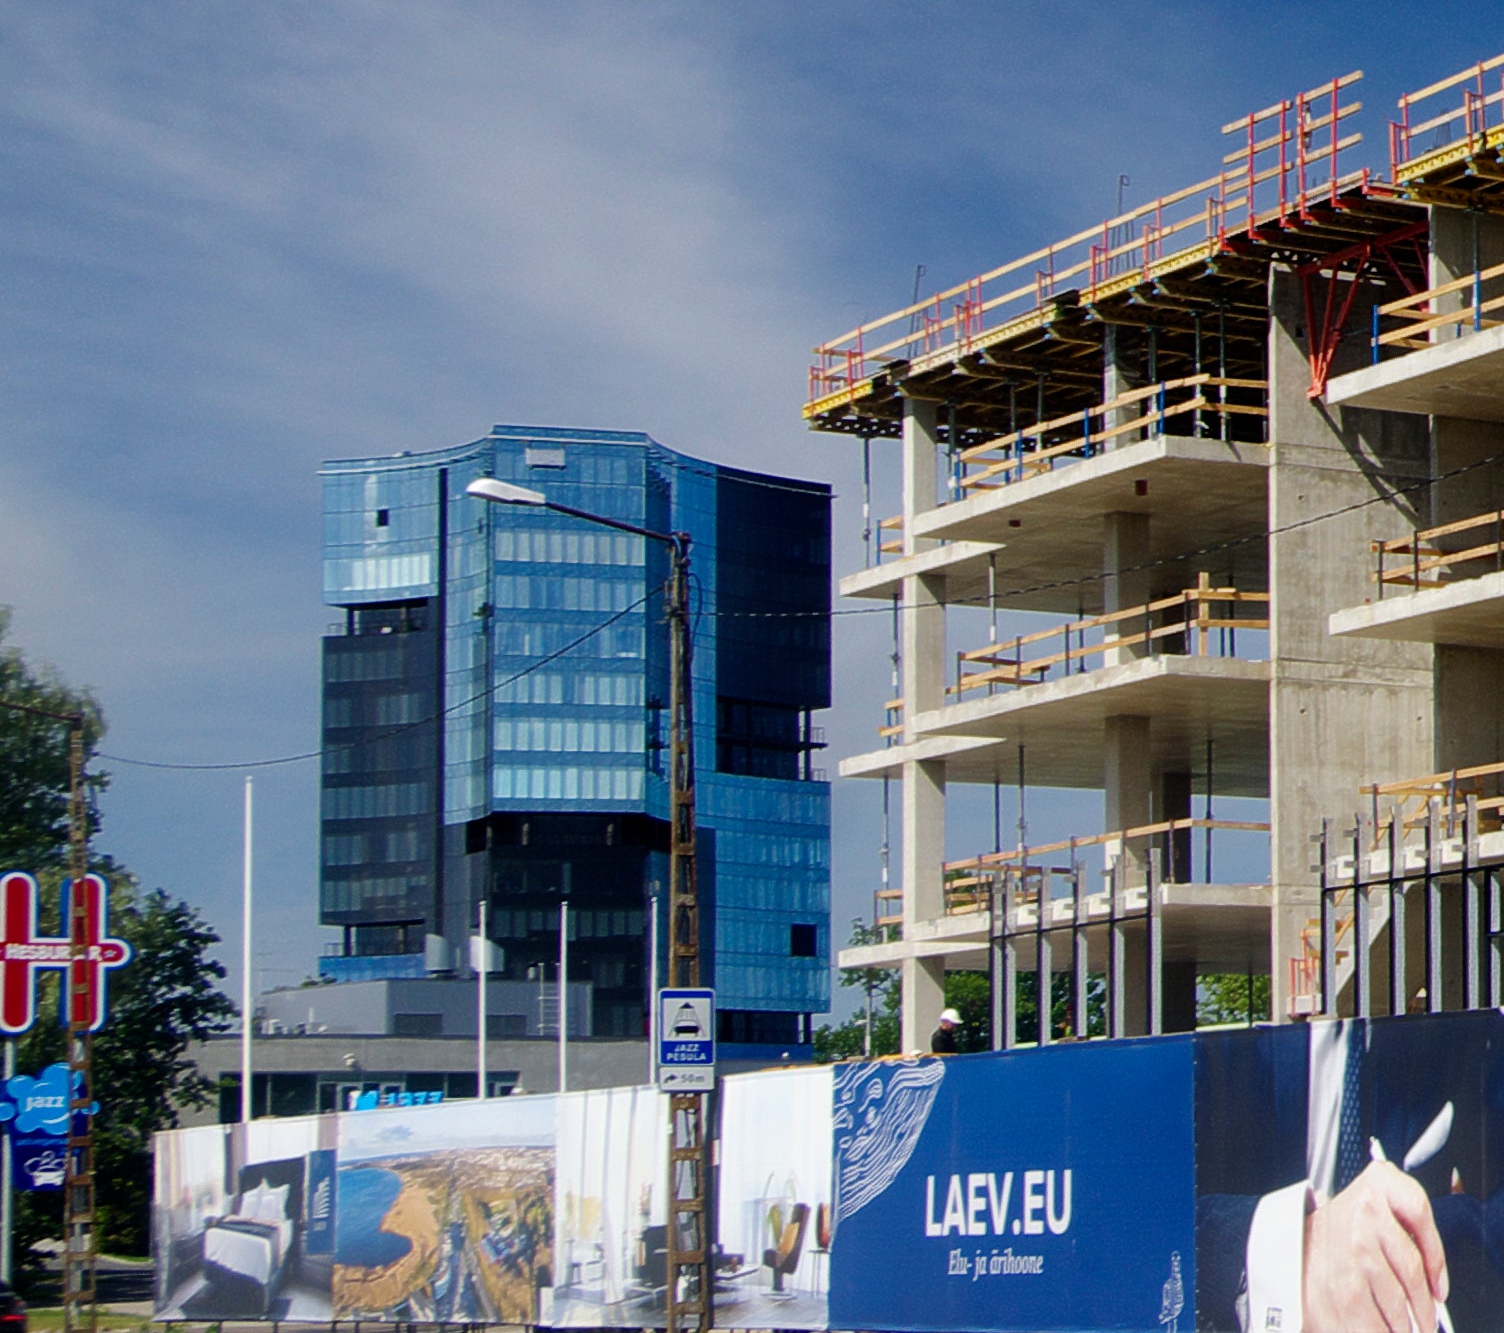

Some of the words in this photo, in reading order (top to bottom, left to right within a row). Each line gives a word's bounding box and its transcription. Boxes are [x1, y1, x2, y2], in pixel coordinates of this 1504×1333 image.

[5, 943, 103, 962] HESBURR
[25, 1096, 66, 1112] jazz
[925, 1169, 1072, 1237] LAEV.EU
[948, 1247, 972, 1275] Elu-
[972, 1249, 987, 1282] ja
[989, 1247, 1043, 1274] ärihoone
